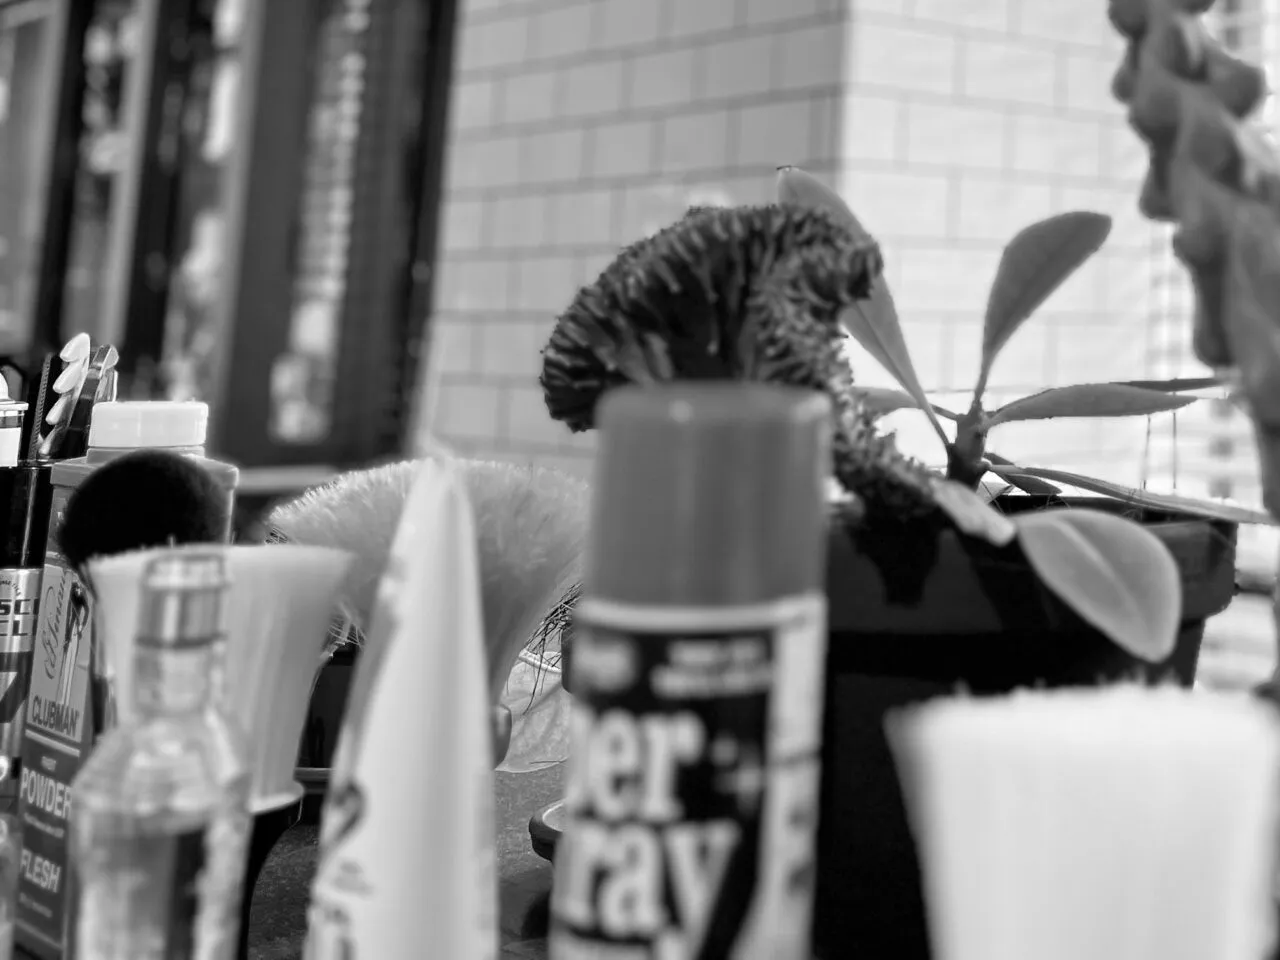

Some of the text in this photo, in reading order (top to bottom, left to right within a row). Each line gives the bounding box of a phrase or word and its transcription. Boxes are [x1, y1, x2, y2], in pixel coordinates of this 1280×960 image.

[32, 695, 80, 737] CLUBMAN
[20, 767, 73, 819] POWDER
[21, 848, 61, 893] FLESH
